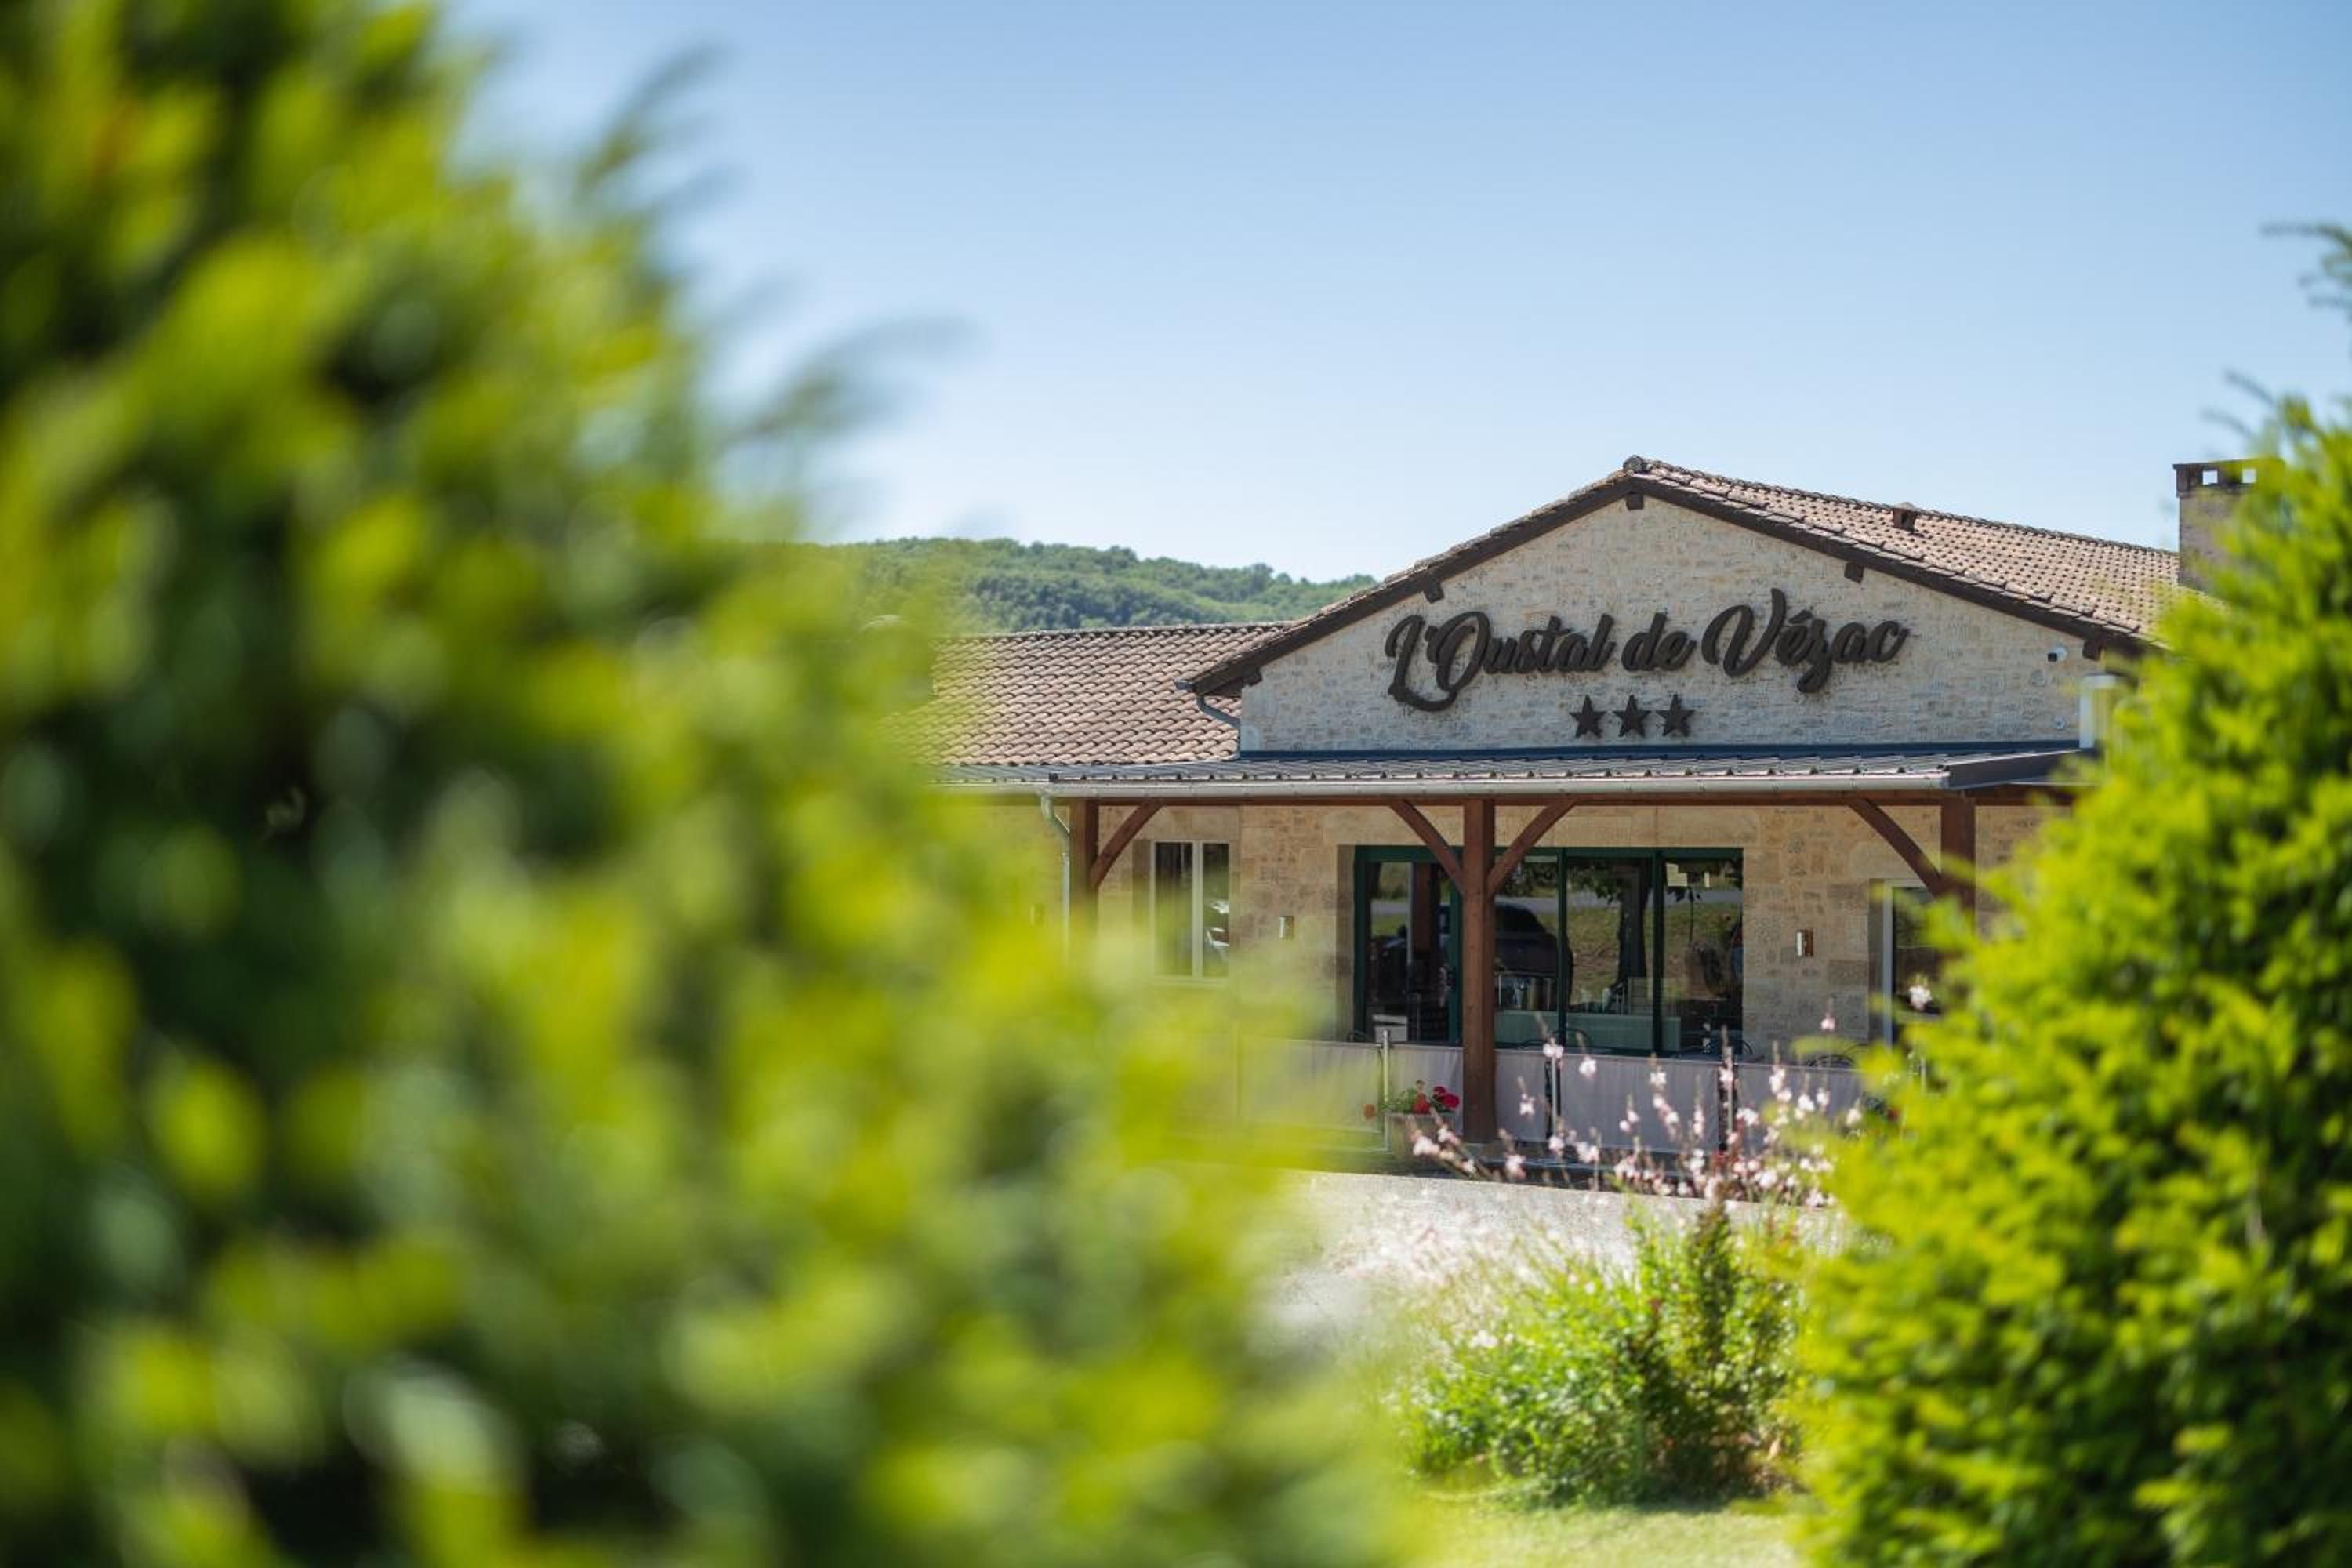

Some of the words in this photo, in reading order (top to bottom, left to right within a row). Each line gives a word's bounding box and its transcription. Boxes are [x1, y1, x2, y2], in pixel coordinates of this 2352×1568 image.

[1385, 611, 1616, 711] L'Oustal
[1621, 612, 1696, 671] de
[1701, 588, 1910, 693] Vézac
